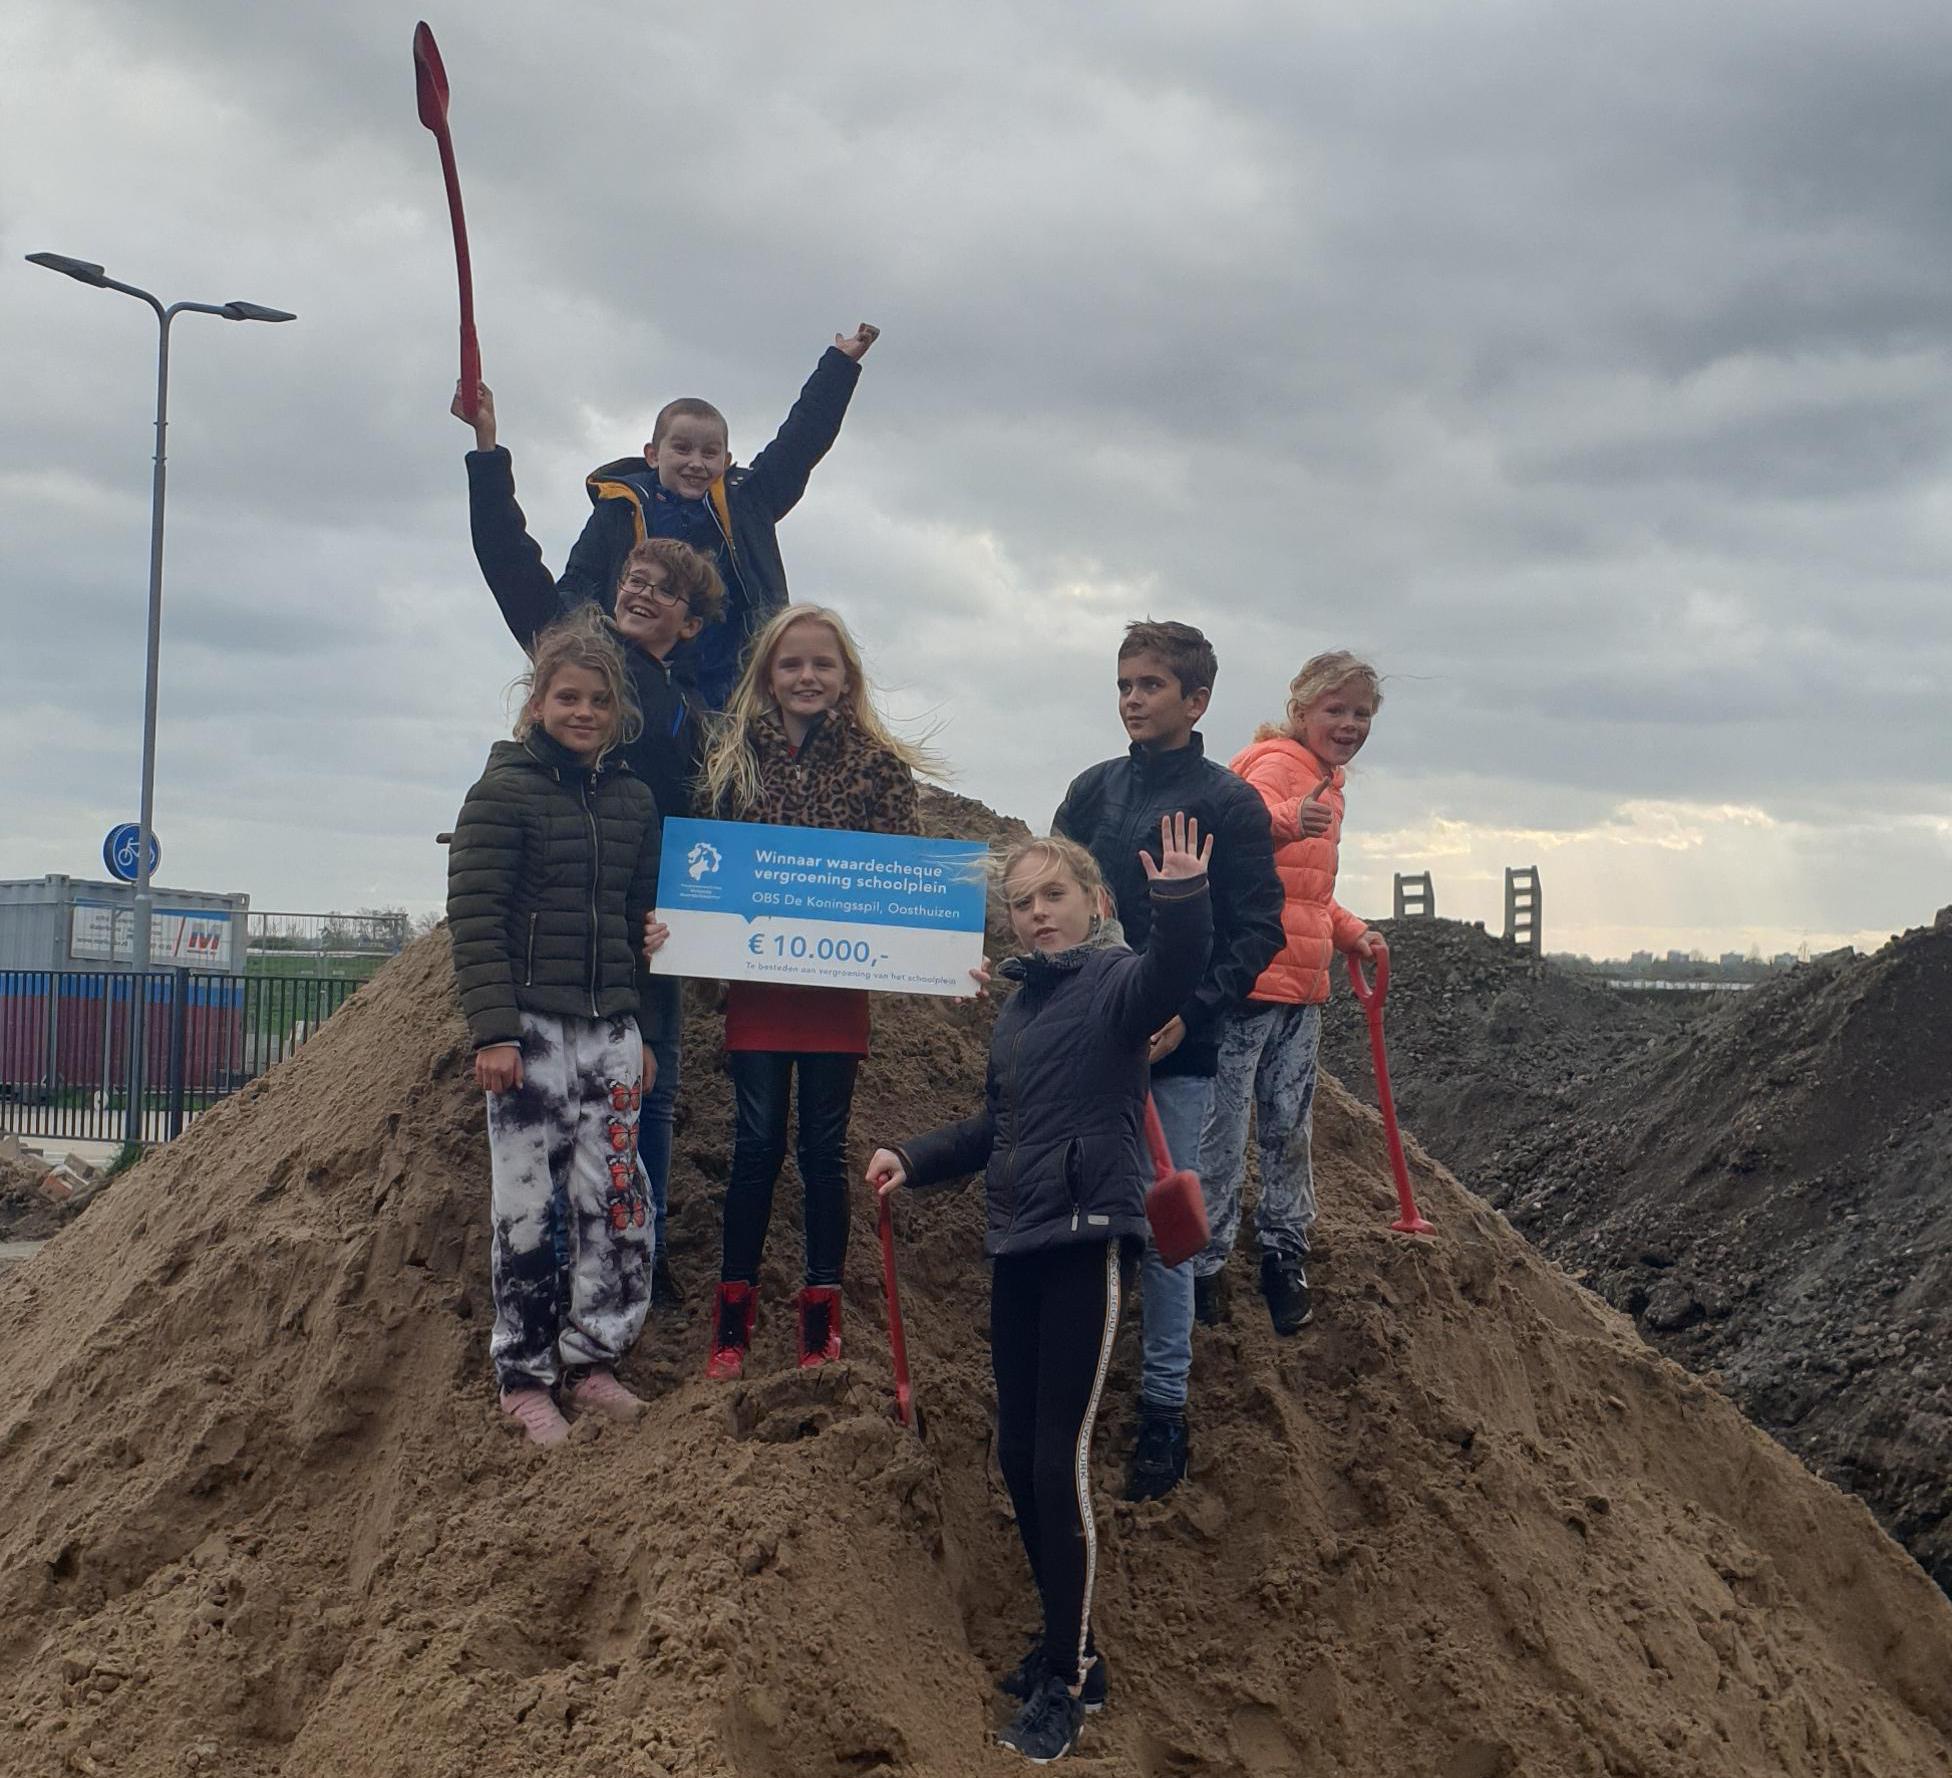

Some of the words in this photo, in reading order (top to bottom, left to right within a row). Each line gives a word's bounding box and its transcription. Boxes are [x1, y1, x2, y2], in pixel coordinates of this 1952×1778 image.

[755, 849, 822, 867] Winnaar
[827, 858, 943, 879] waardecheque
[754, 869, 852, 890] vergroening
[856, 875, 947, 895] schoolplein
[751, 891, 780, 905] OBS
[784, 894, 803, 906] De
[807, 896, 883, 914] Koningsspil,
[888, 902, 960, 919] Oosthuizen
[748, 932, 765, 955] €
[774, 935, 889, 968] 10.000,-
[746, 961, 755, 969] Te
[758, 962, 799, 974] besteden
[800, 966, 816, 974] aan
[819, 967, 871, 980] vergroening
[891, 972, 905, 981] het
[907, 975, 957, 986] schoolplein
[1079, 1444, 1088, 1480] YORK
[1082, 1489, 1093, 1531] TOKYO
